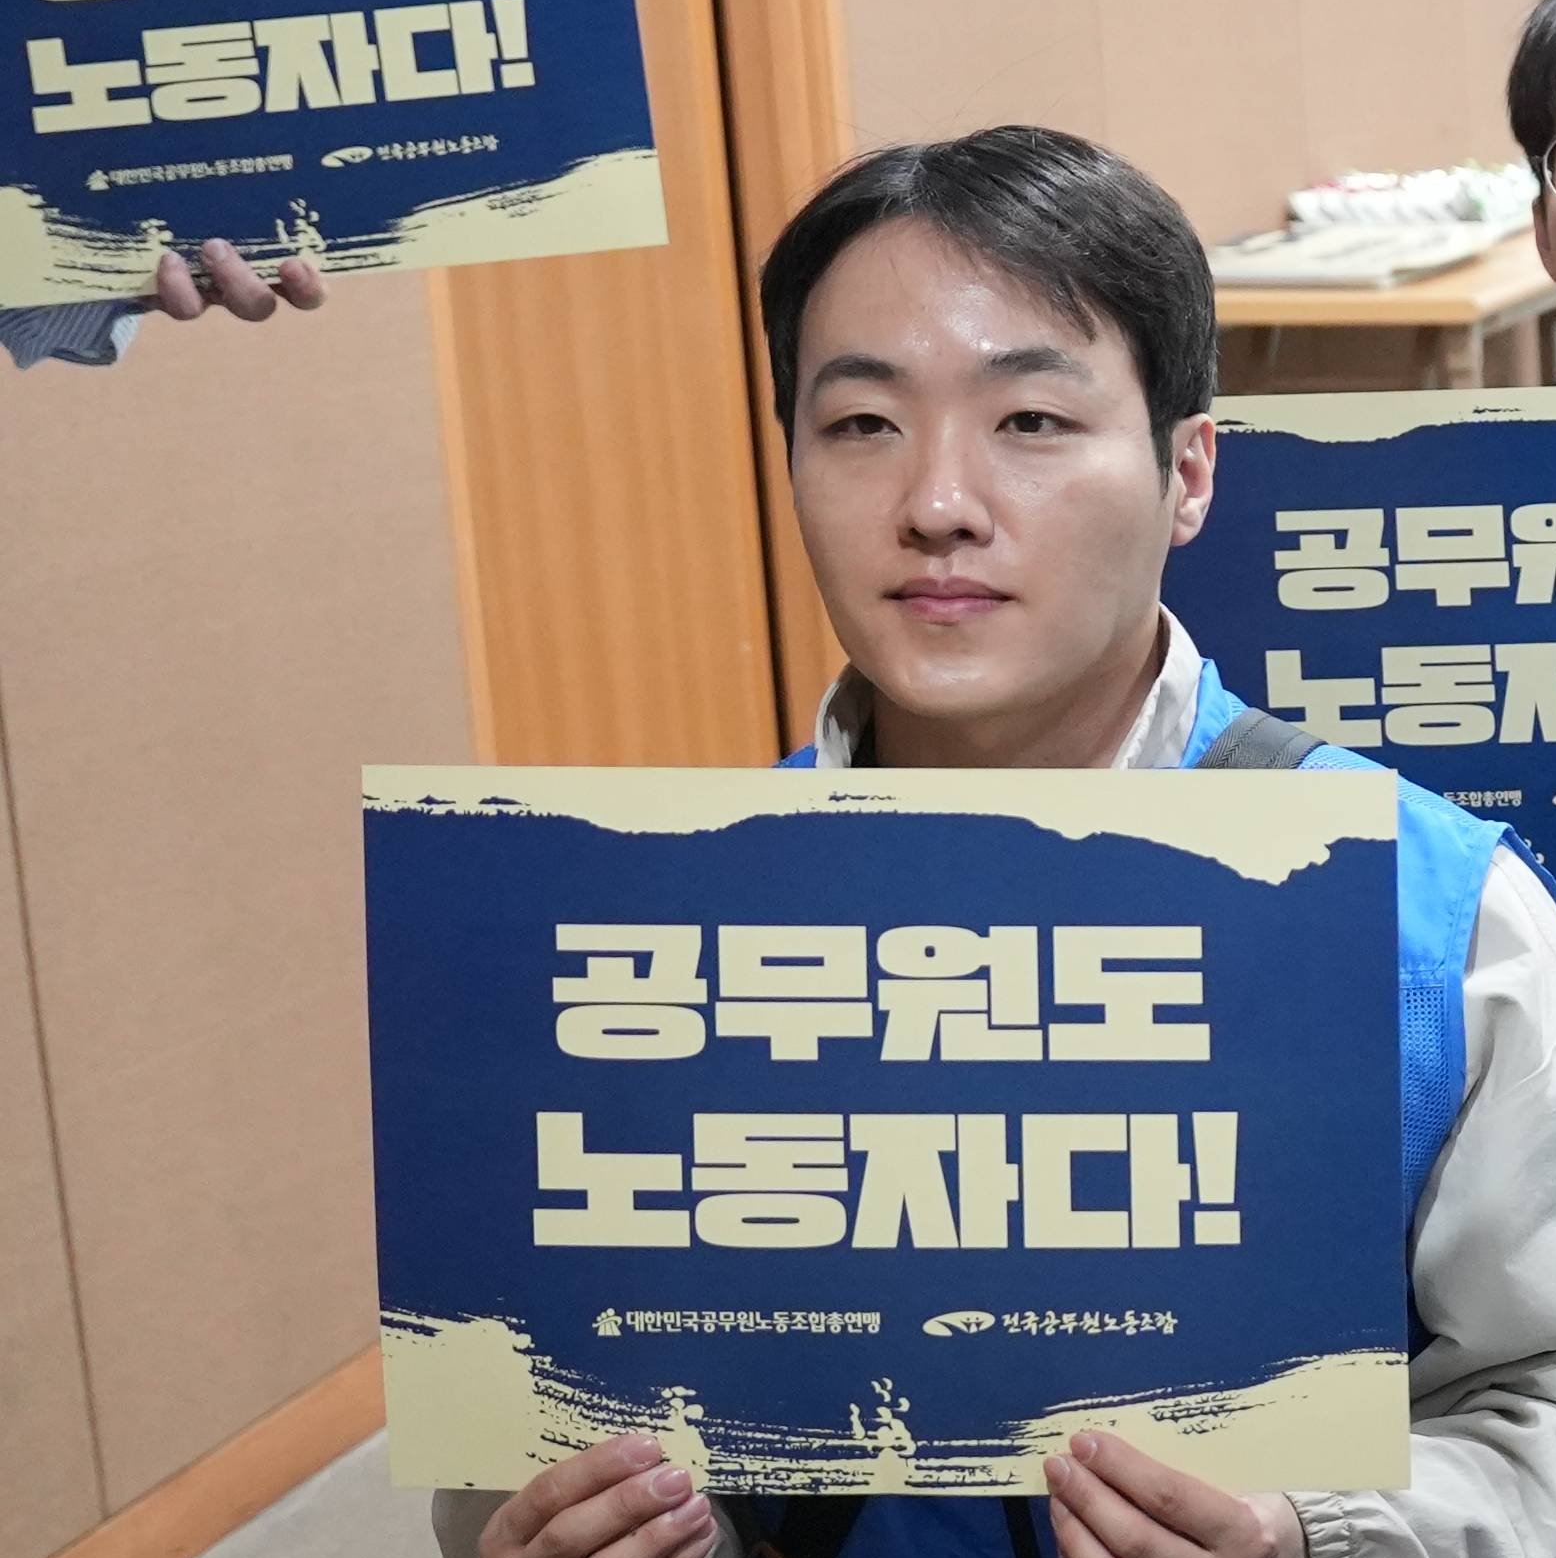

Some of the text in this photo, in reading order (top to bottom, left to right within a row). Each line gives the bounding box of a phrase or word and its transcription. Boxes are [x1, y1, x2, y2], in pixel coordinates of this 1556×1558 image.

[553, 924, 1210, 1061] 공무원도
[533, 1112, 1240, 1248] 노동자다!
[626, 1310, 1178, 1335] 대한민국공무원노동조합총연맹 전국공무원노동조합
